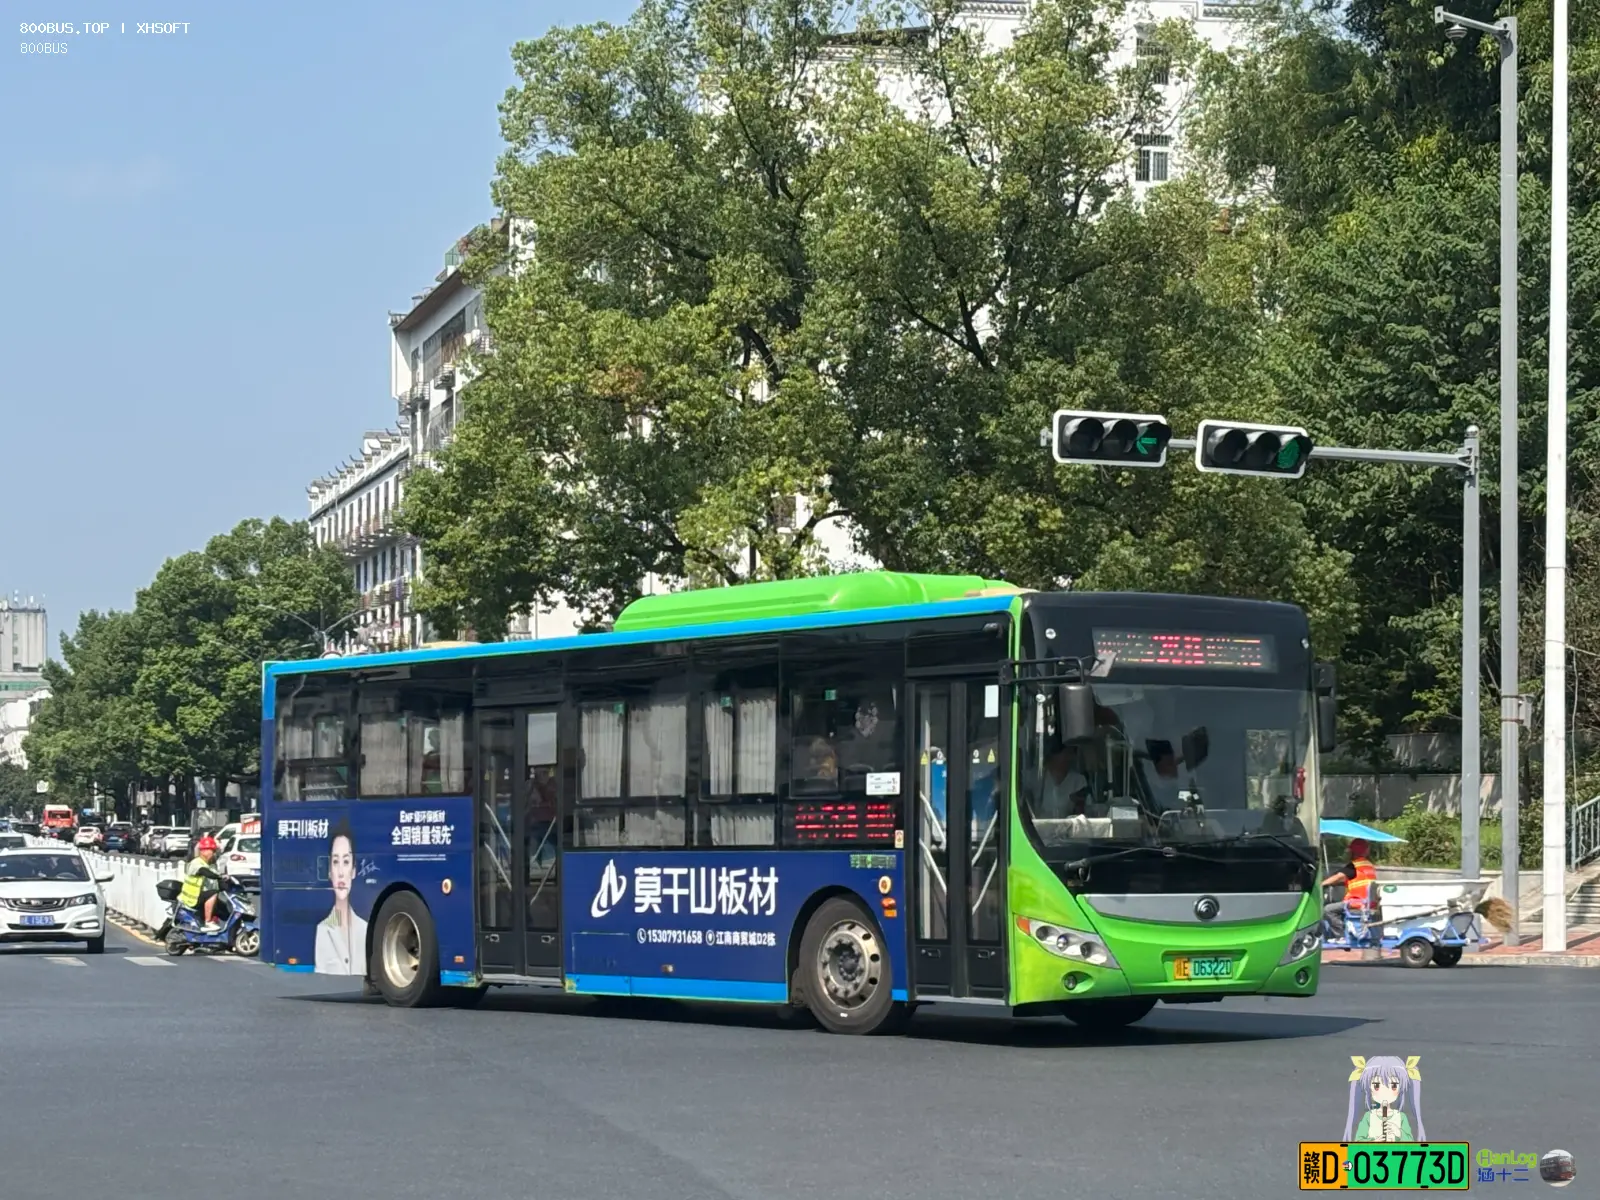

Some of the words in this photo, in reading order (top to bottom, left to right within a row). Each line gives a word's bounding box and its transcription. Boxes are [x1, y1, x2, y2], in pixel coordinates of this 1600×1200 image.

[277, 818, 330, 839] 莫干山板材
[634, 866, 779, 916] 莫干山板材
[647, 929, 702, 945] 15307931658
